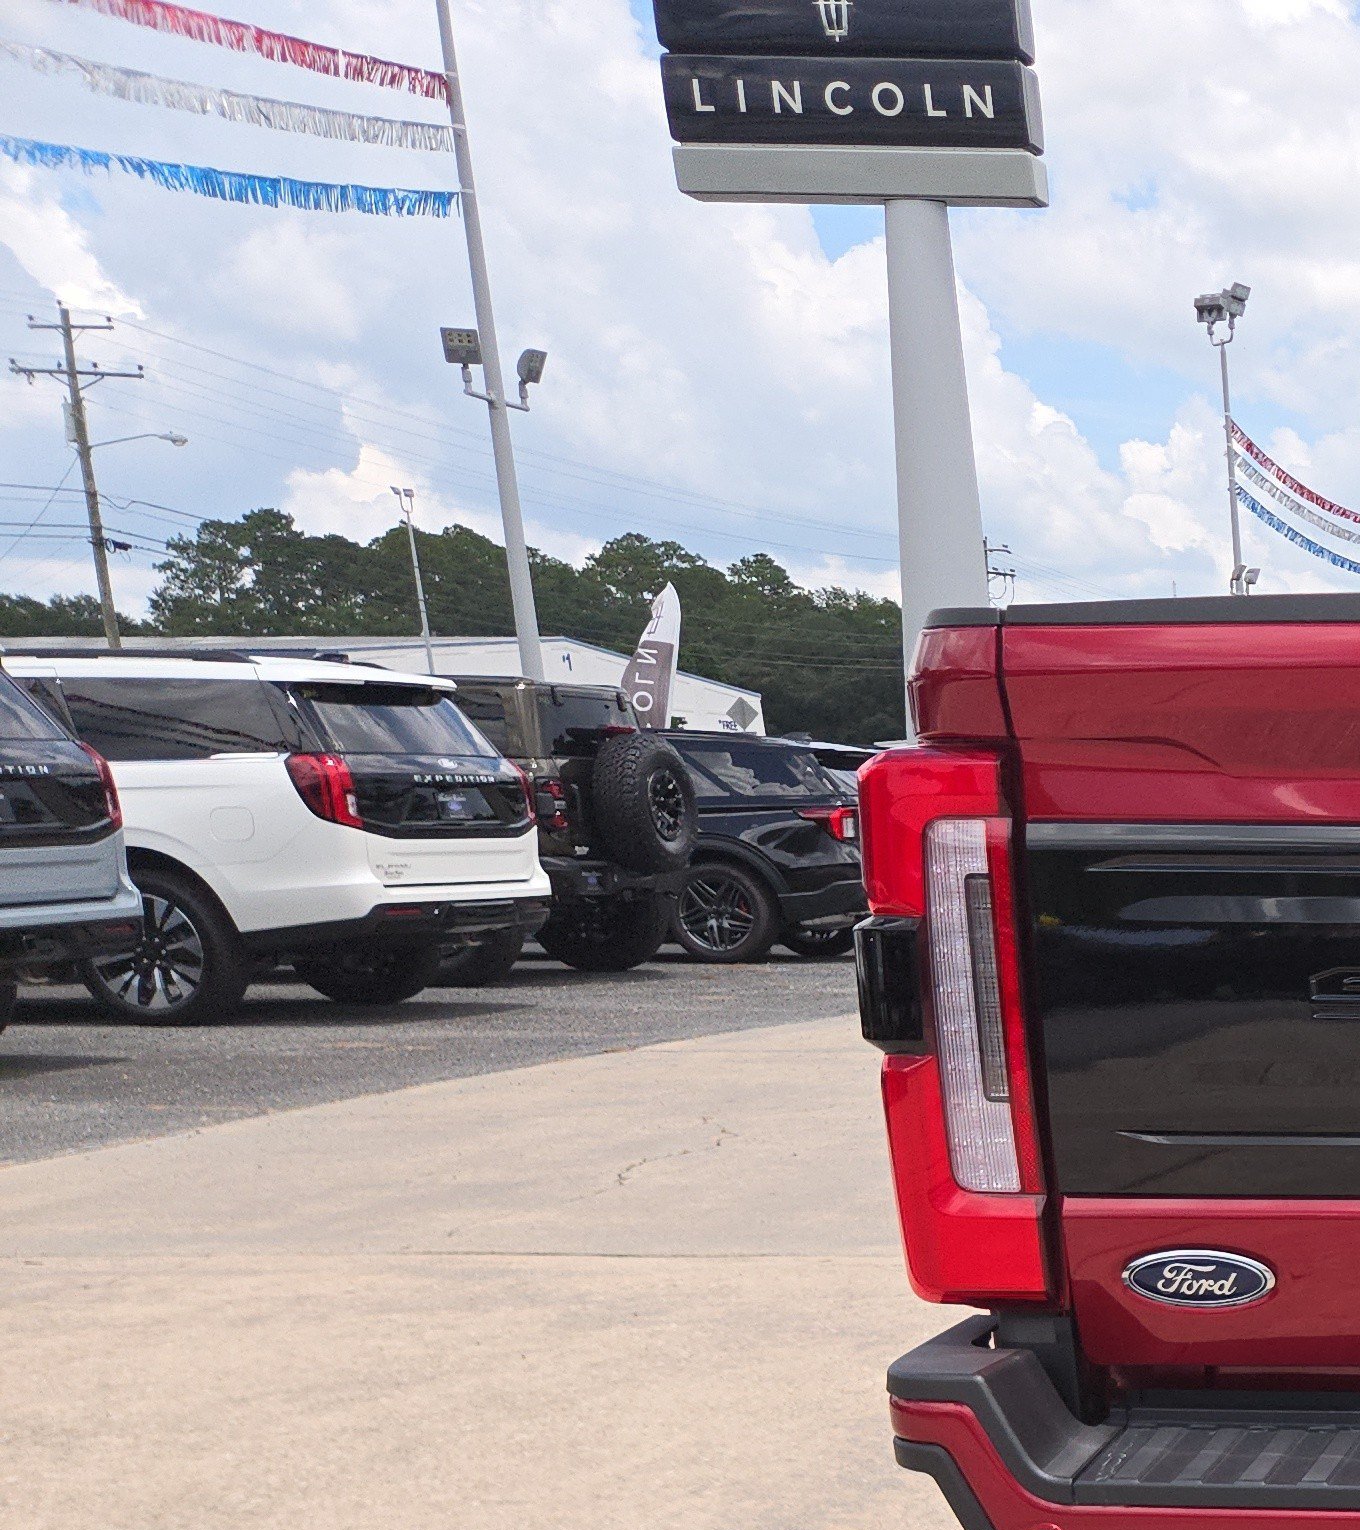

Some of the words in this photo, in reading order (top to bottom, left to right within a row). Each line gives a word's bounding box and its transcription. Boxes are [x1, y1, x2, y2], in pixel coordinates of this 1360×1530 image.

[691, 78, 994, 119] LINCOLN
[413, 774, 496, 783] EXPEDITION
[1156, 1263, 1237, 1295] Ford
